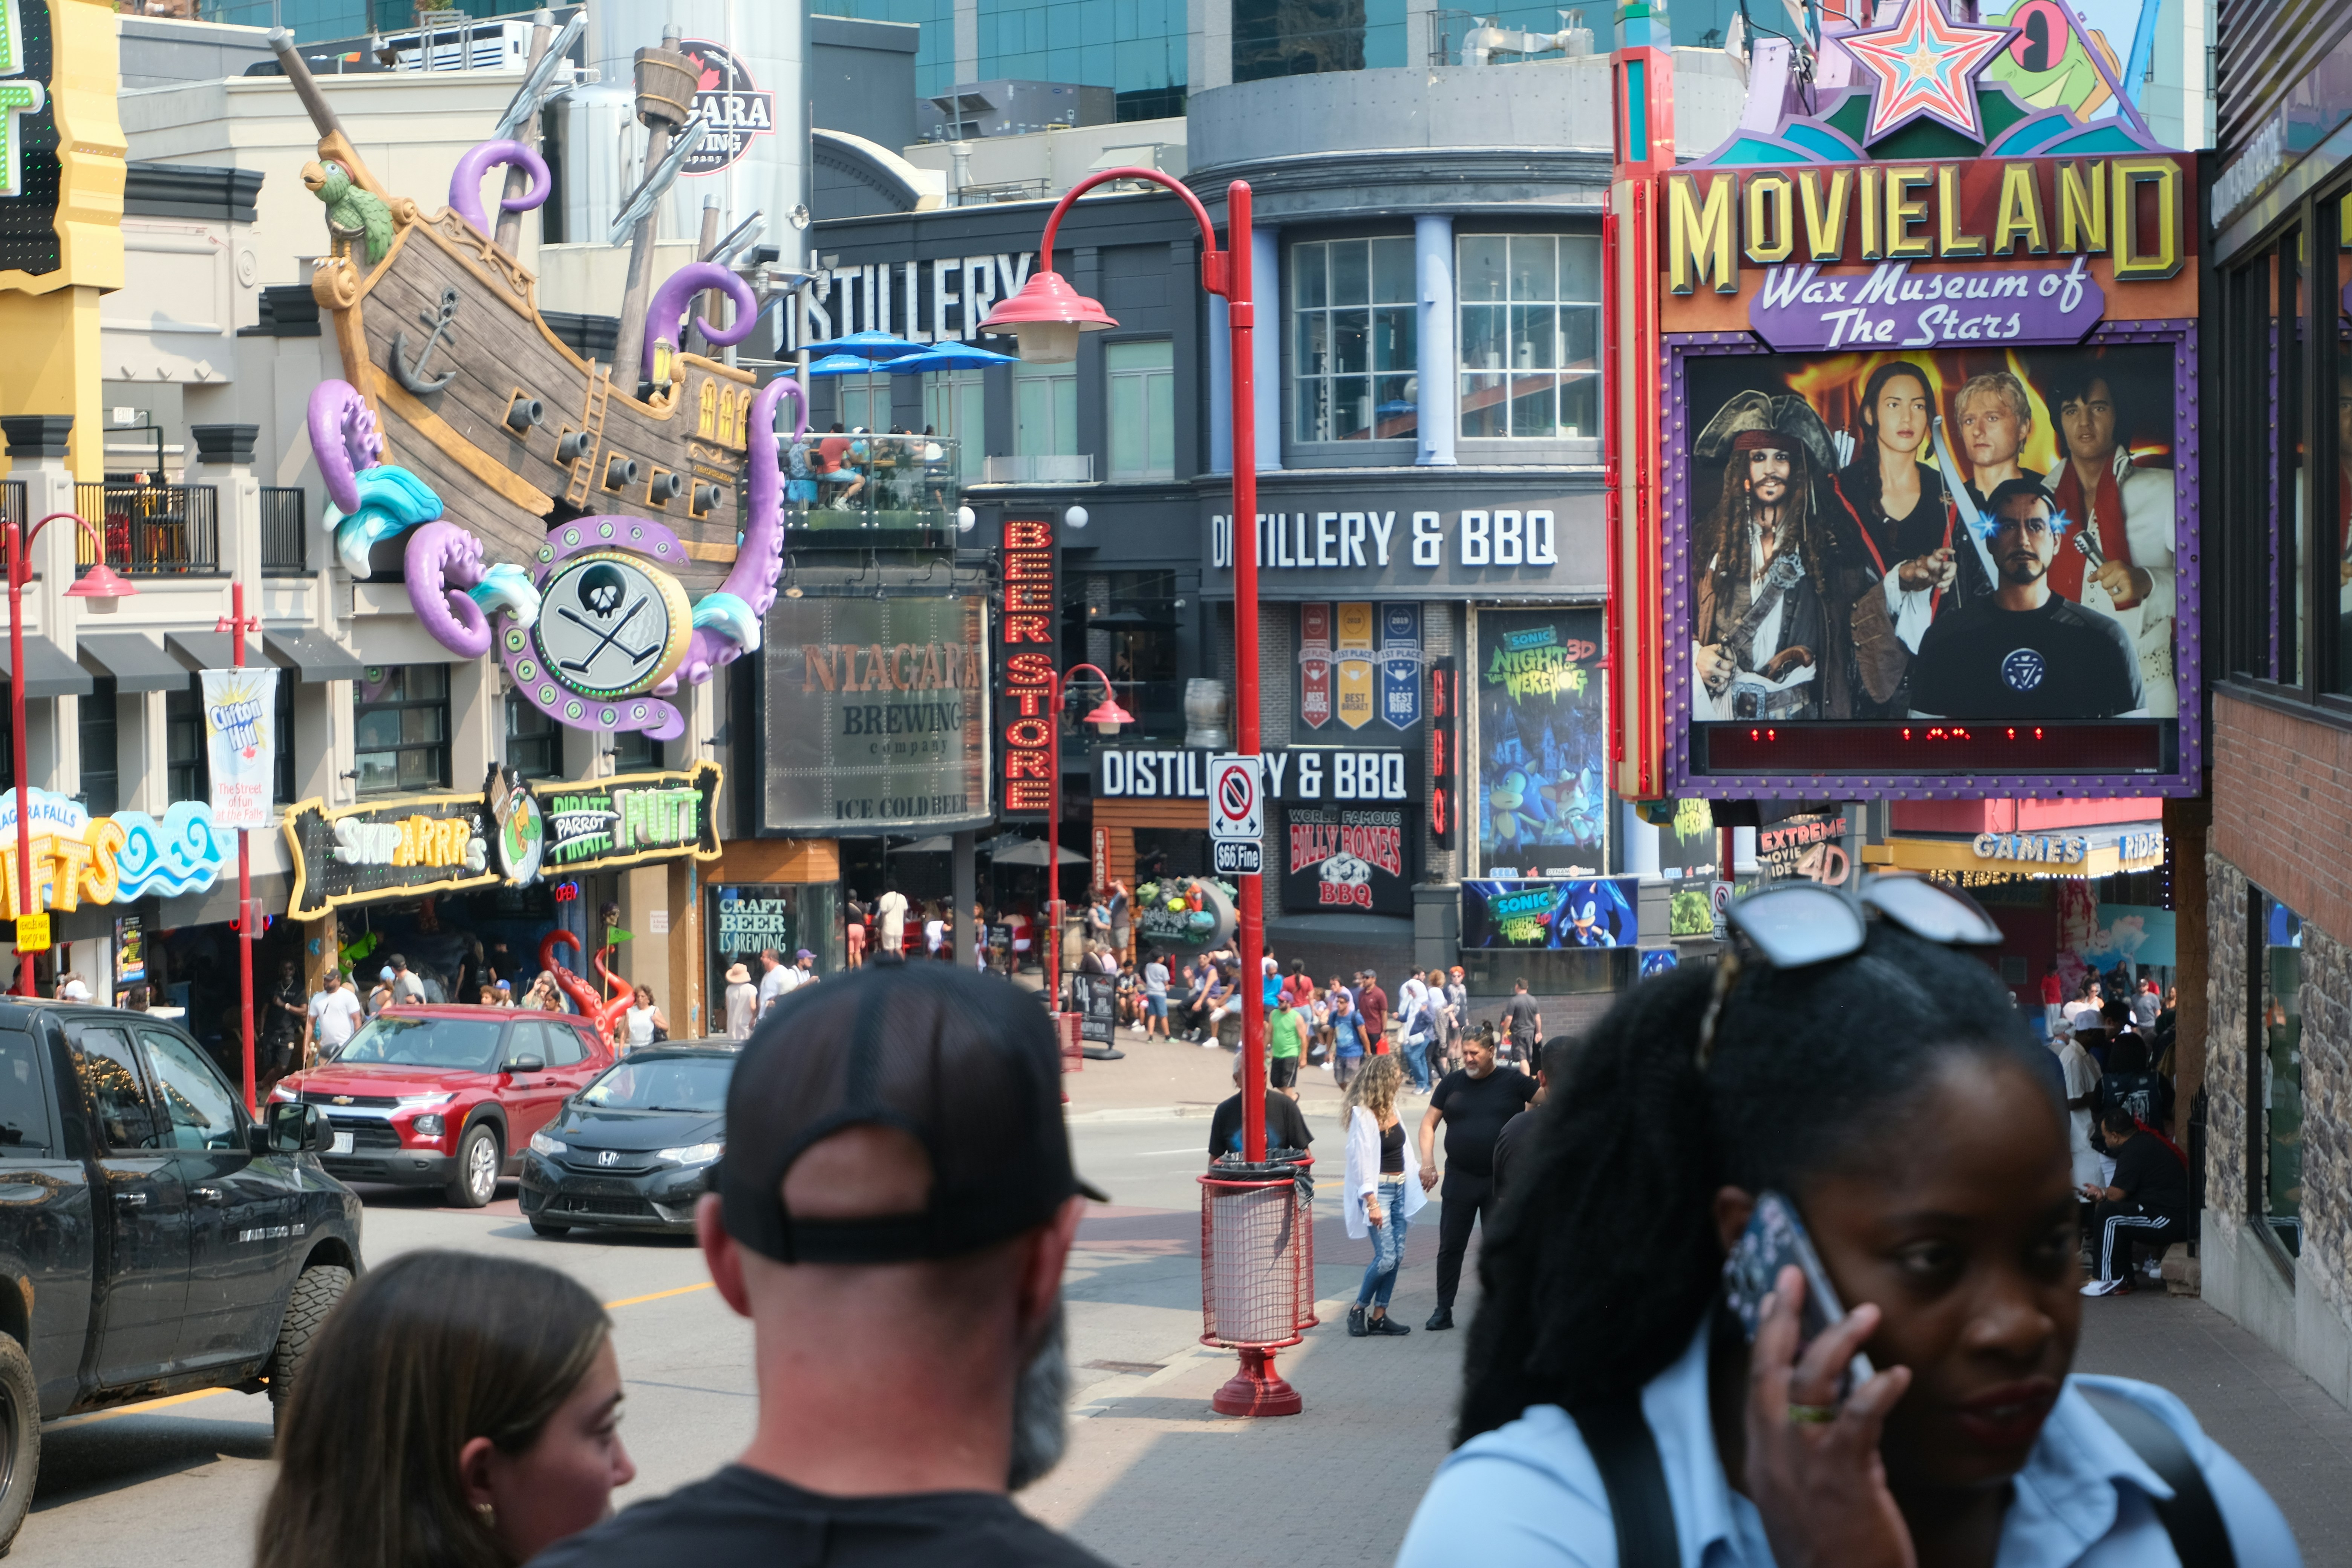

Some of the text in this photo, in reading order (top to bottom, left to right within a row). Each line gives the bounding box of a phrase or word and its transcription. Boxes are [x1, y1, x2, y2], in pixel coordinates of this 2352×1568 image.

[1668, 157, 2184, 295] MOVIELAND
[1762, 257, 2087, 314] Wax Museum of
[1820, 305, 2021, 348] The Stars
[1212, 510, 1558, 567] DITILLERY & BBQ
[1004, 521, 1053, 643] BEER
[1511, 631, 1550, 646] SONIC
[1565, 638, 1597, 662] 3D
[1351, 649, 1372, 659] PLACE
[1381, 649, 1421, 659] 1ST PLACE
[1488, 645, 1568, 674] NIGHT
[801, 642, 980, 692] NIAGARA
[1564, 662, 1578, 671] OF
[1305, 701, 1328, 712] SAUCE
[1306, 692, 1325, 702] BEST
[1341, 703, 1369, 711] BRISKET
[1344, 693, 1366, 702] BEST
[1389, 692, 1414, 702] BEST
[1389, 702, 1413, 712] RIBS
[210, 698, 263, 730] Clifton
[842, 702, 962, 735] BREWING
[228, 723, 259, 752] Hill
[1006, 652, 1052, 810] STORE
[870, 739, 948, 756] company
[1299, 753, 1323, 798] &
[1335, 752, 1407, 799] BBQ
[218, 782, 263, 794] The Street
[228, 795, 253, 807] of fun
[835, 793, 968, 821] ICE COLD BEER
[43, 804, 77, 828] FALLS
[216, 807, 263, 821] at the Falls
[617, 788, 703, 848] PUTT
[1289, 808, 1402, 825] WORLD FAMOUS
[556, 816, 606, 840] PARROT
[1761, 818, 1847, 853] EXTREME
[1217, 844, 1259, 868] $66 Fine
[1290, 824, 1401, 877] BILLY BONES
[1973, 833, 2085, 864] GAMES
[2122, 832, 2164, 859] RIDES
[0, 817, 127, 922] IFTS
[1096, 830, 1105, 889] ENTRANCE
[1772, 861, 1792, 877] IDE
[1794, 842, 1851, 886] 4D
[1490, 867, 1519, 878] SEGA
[556, 885, 577, 903] OPEN
[719, 898, 786, 914] CRAFT
[1319, 880, 1374, 909] BBQ
[1498, 891, 1550, 914] SONIC
[38, 919, 48, 929] HAVE
[719, 914, 786, 934] BEER
[1500, 916, 1537, 930] NIGHT
[1535, 913, 1552, 926] 4D
[719, 933, 786, 955] IS BREWING
[1075, 975, 1090, 1012] $4
